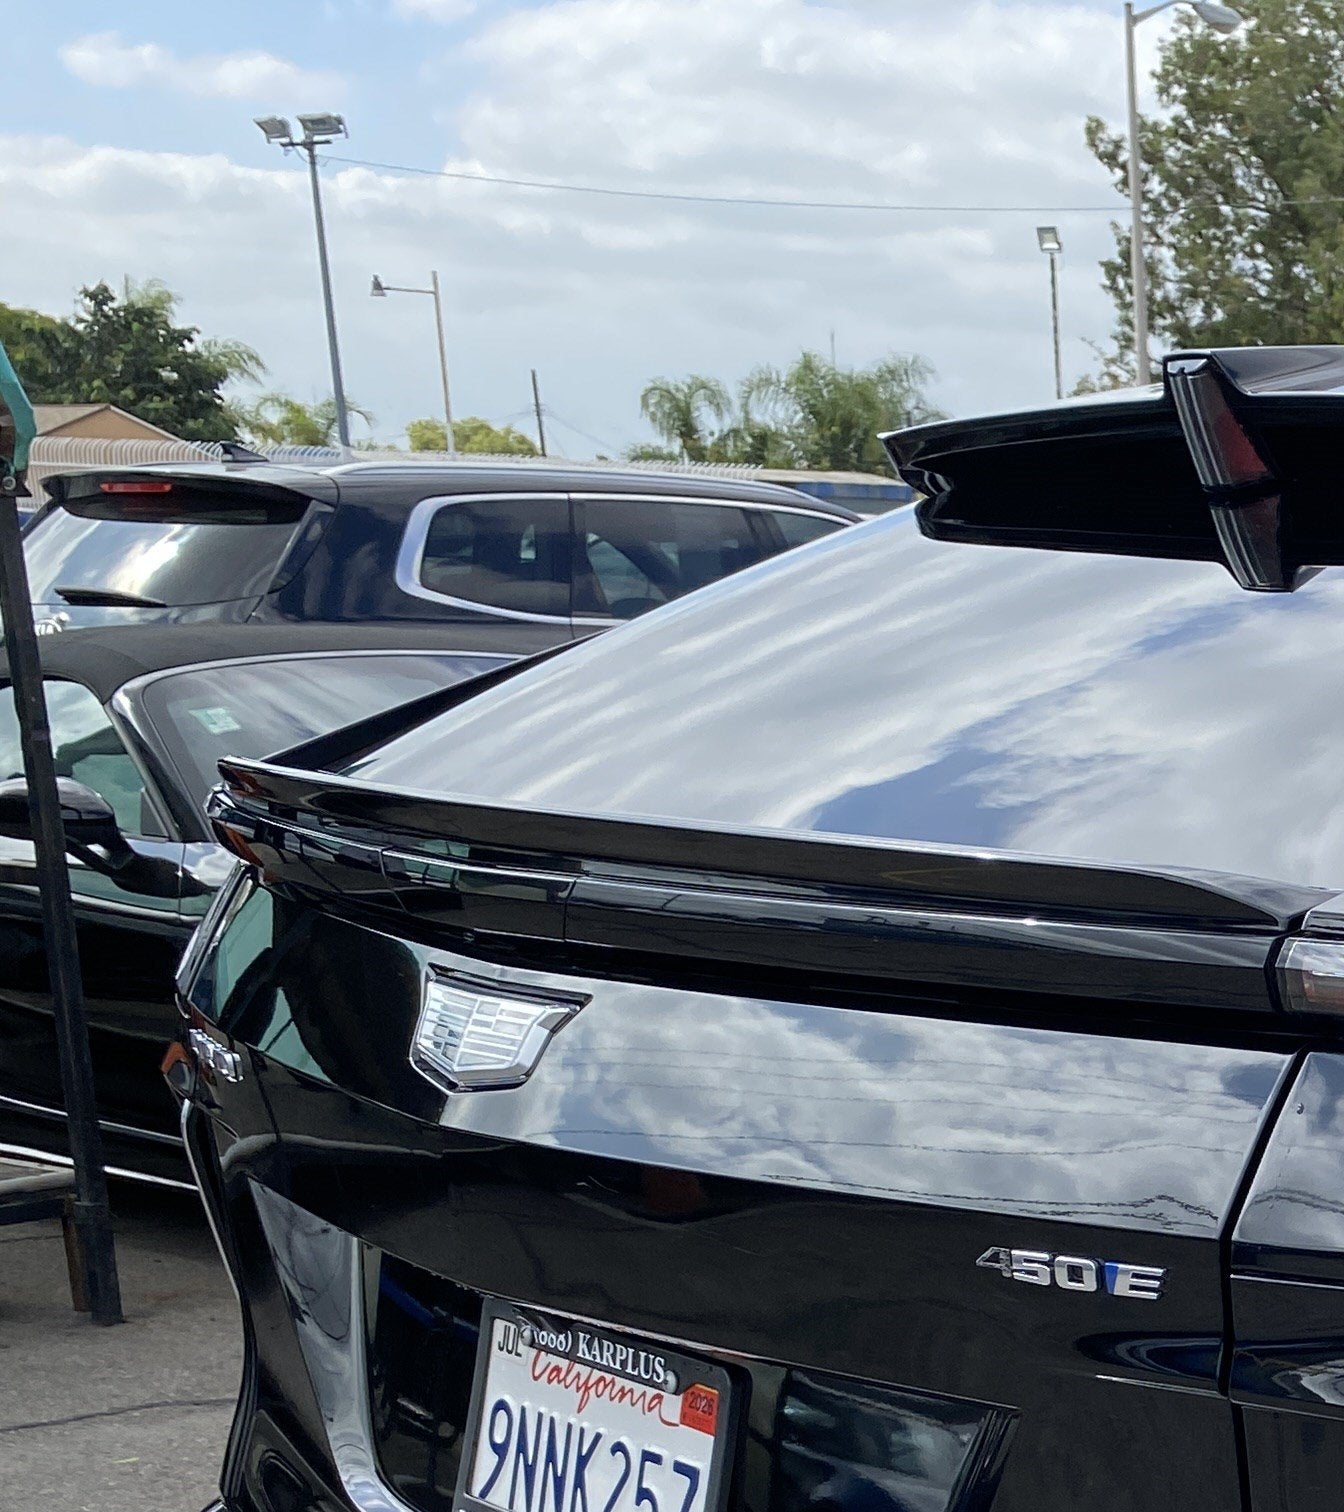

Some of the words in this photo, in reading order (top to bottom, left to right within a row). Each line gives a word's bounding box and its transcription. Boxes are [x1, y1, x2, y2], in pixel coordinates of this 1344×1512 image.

[497, 1324, 522, 1358] JUL
[577, 1331, 668, 1384] KARPLUS
[531, 1350, 680, 1428] California
